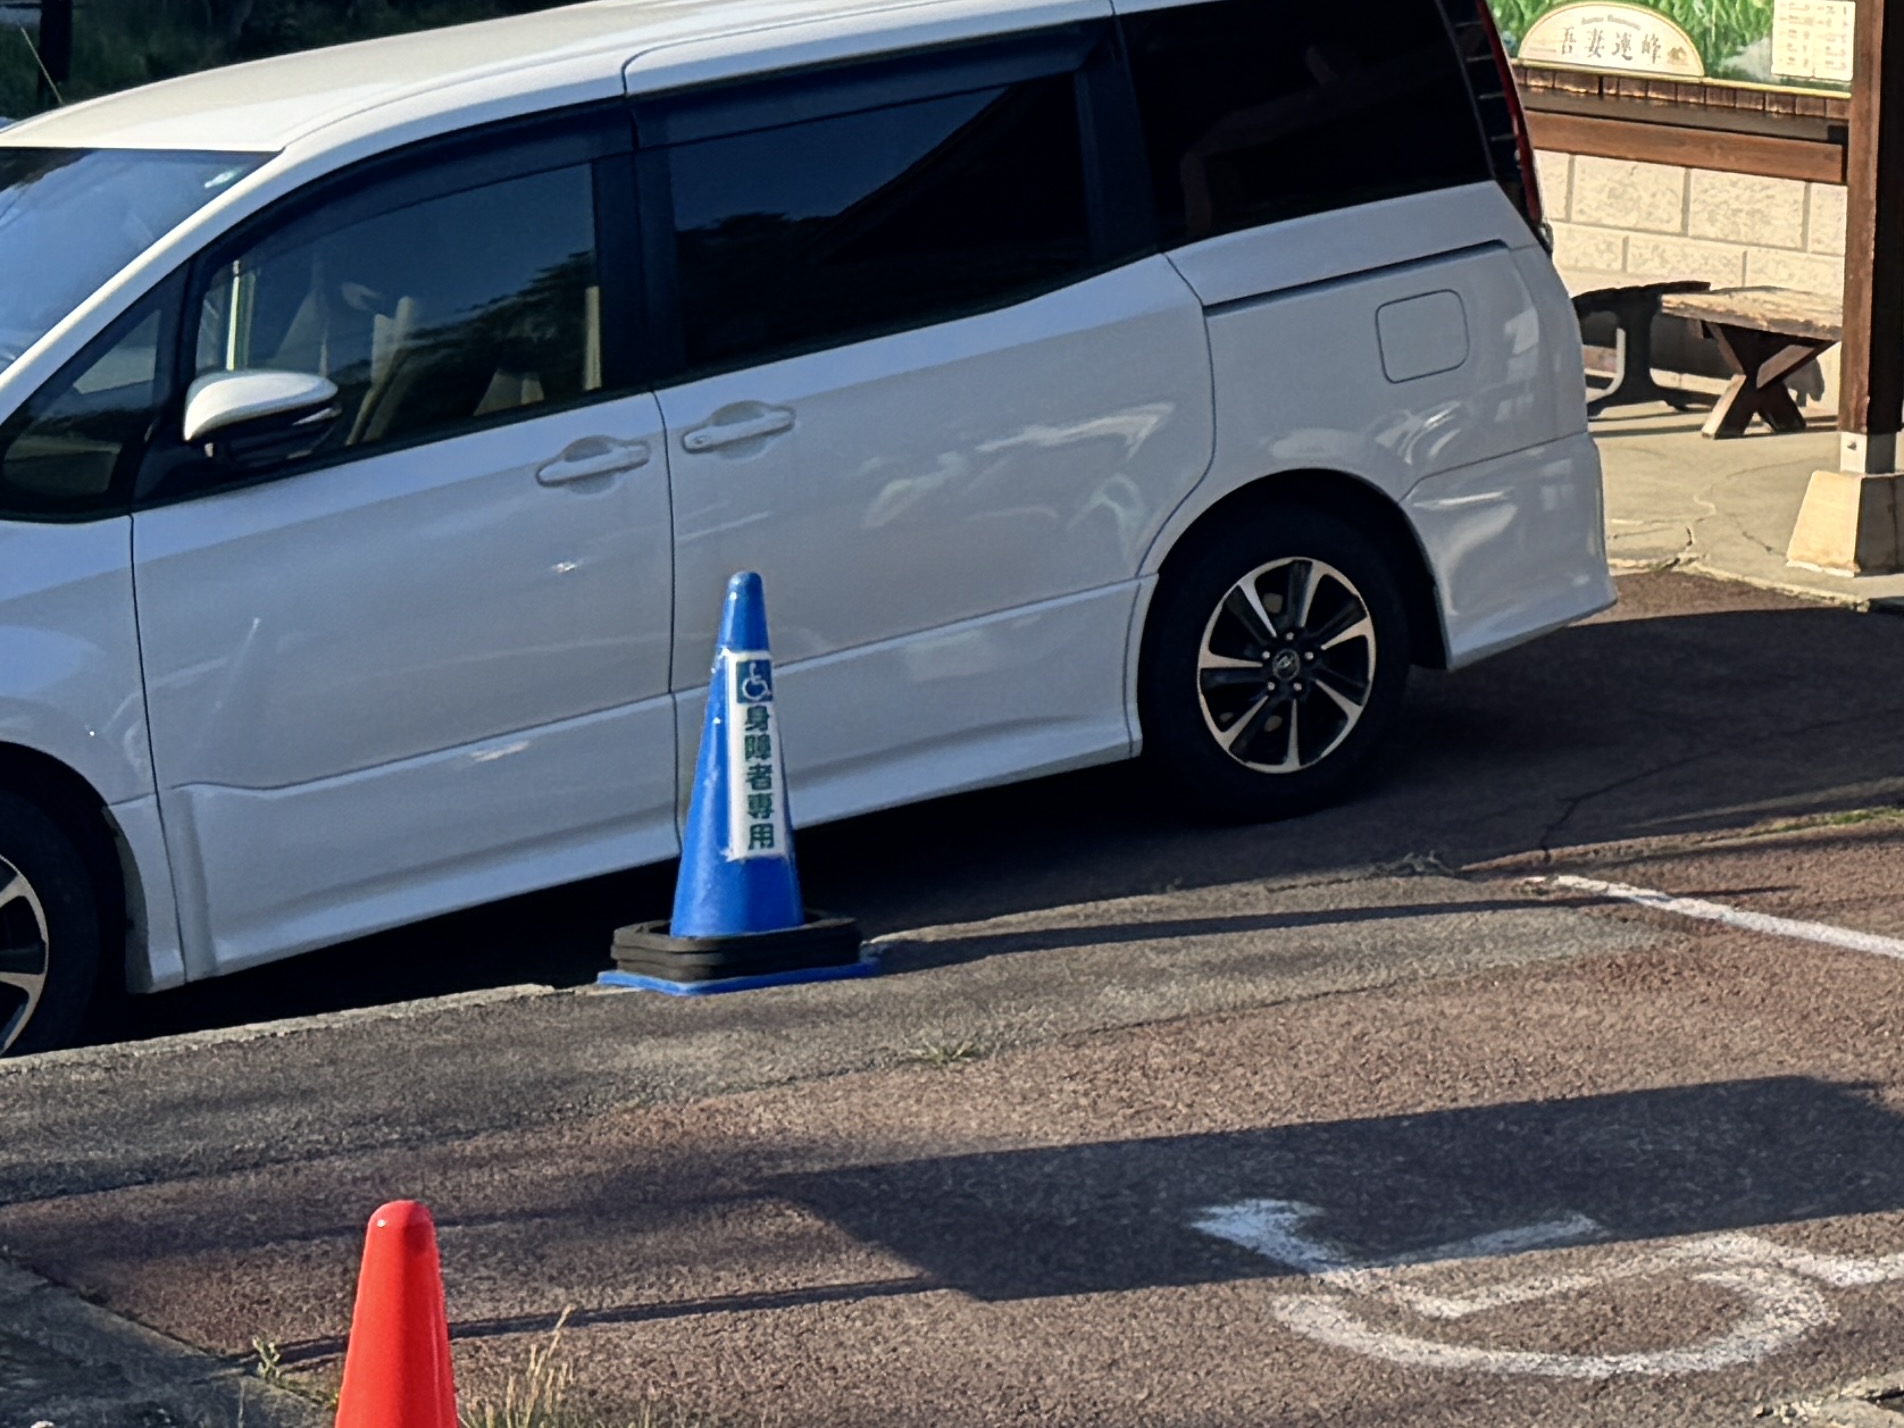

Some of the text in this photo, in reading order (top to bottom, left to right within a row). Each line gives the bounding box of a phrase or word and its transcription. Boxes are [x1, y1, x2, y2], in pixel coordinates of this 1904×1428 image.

[1561, 25, 1661, 64] 吾妻連峰
[744, 704, 775, 850] 身障者専用
